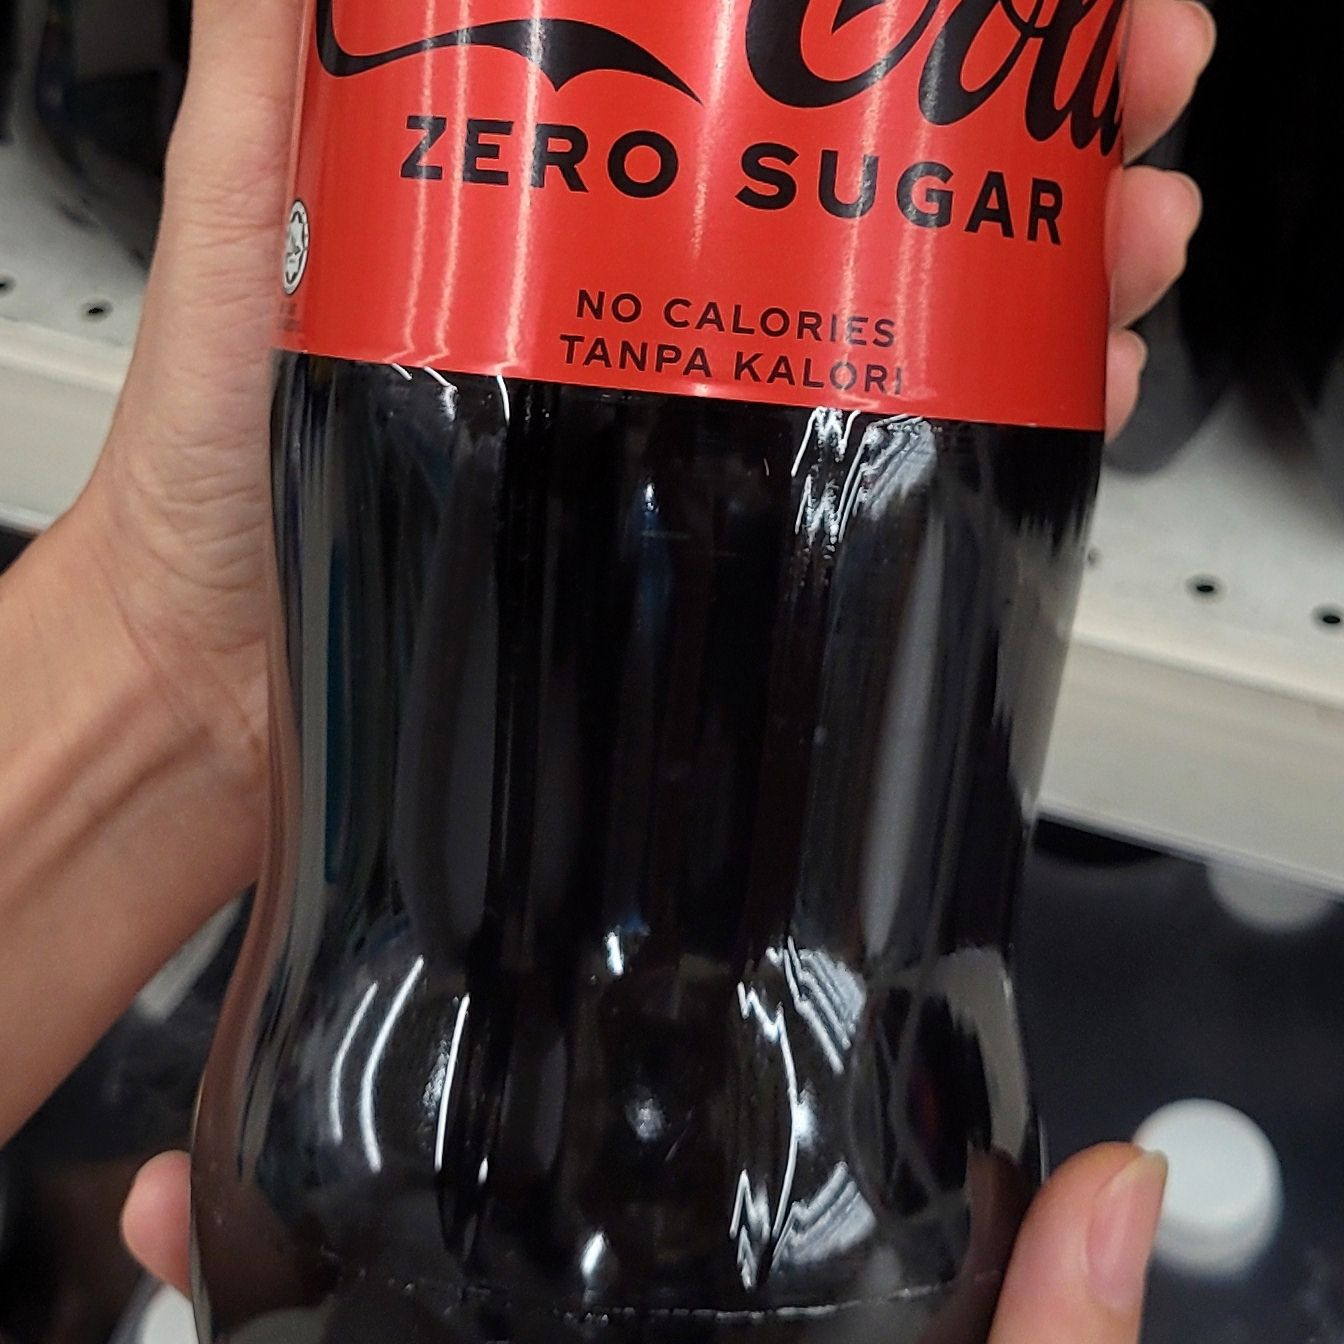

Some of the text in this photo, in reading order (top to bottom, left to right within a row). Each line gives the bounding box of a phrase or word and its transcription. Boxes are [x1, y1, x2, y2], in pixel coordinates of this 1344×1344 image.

[400, 114, 1064, 248] ZERO SUGAR
[575, 288, 895, 348] NO CALORIES
[559, 333, 903, 396] TANPA KALORI
